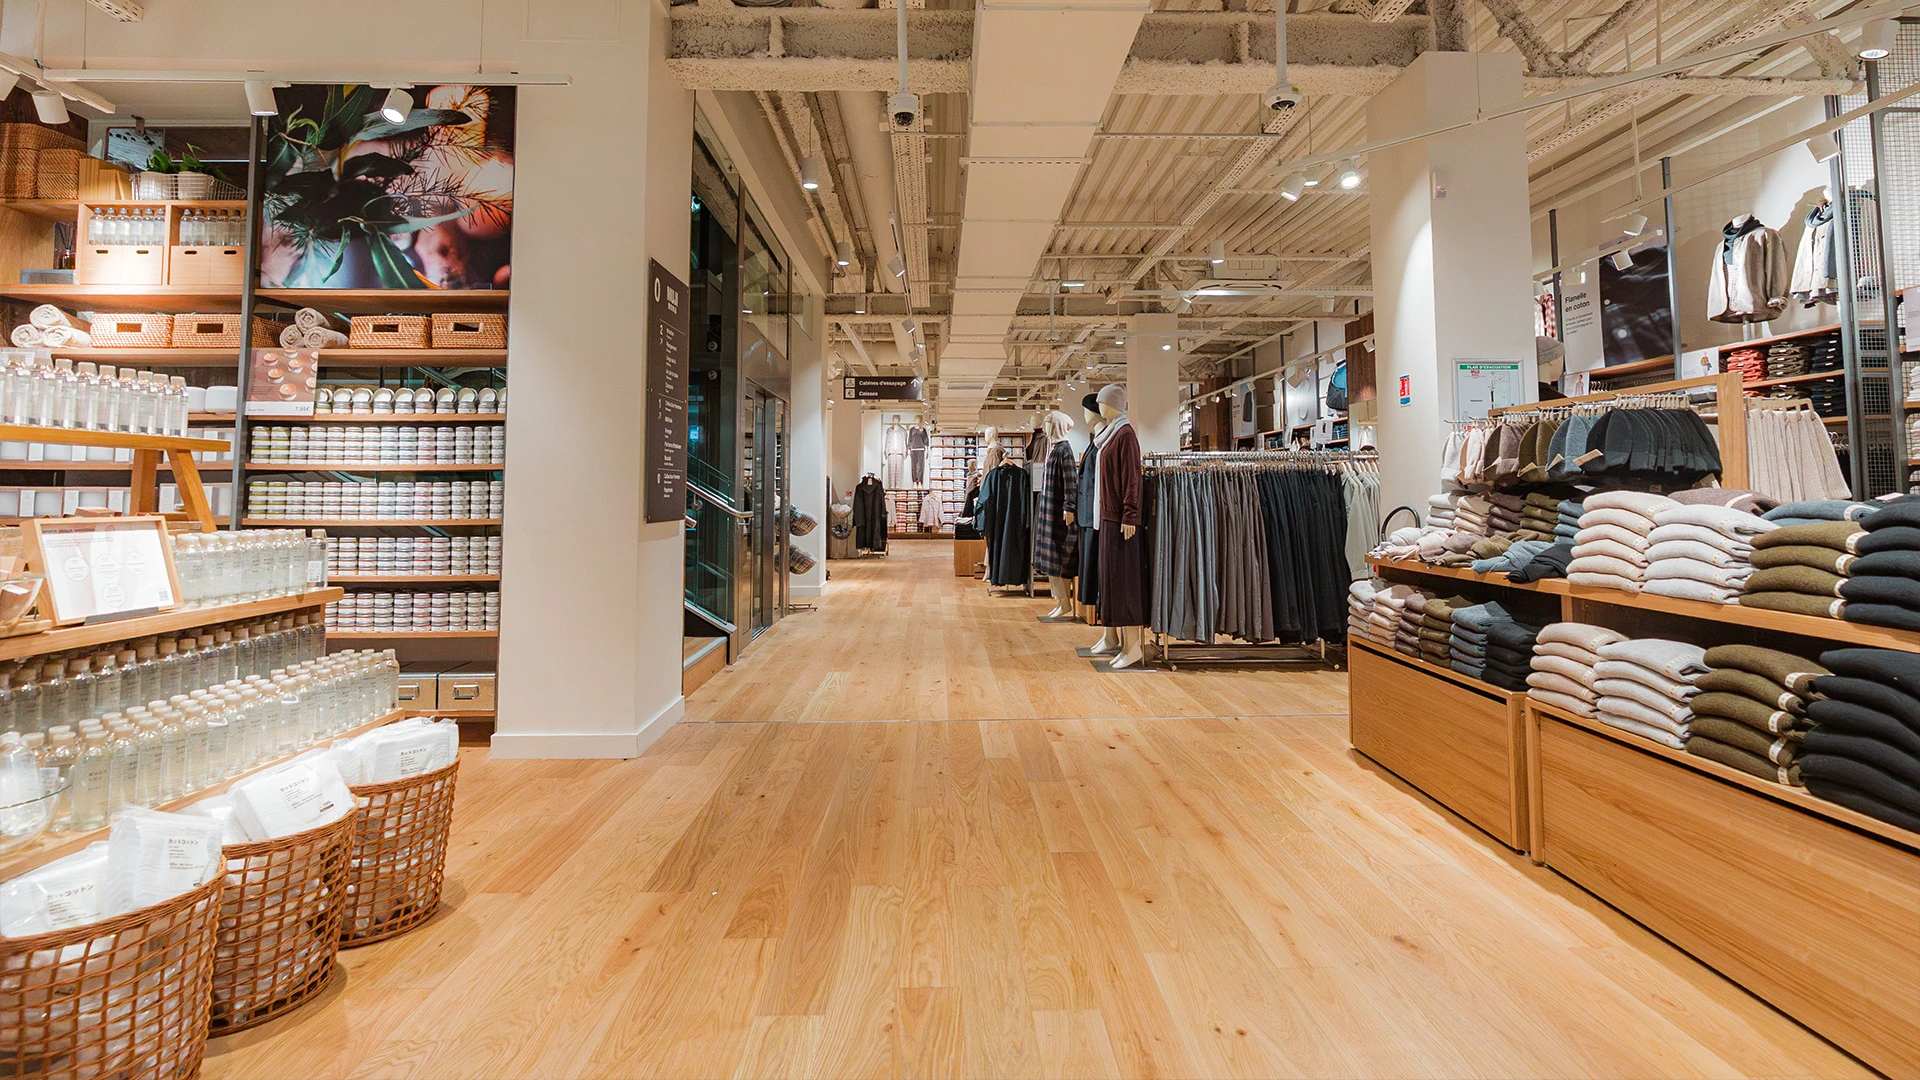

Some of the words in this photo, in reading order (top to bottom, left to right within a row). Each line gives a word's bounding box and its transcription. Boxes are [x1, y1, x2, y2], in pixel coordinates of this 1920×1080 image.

[654, 277, 661, 303] 0
[1565, 292, 1586, 303] Flanelle
[1573, 300, 1590, 310] coton
